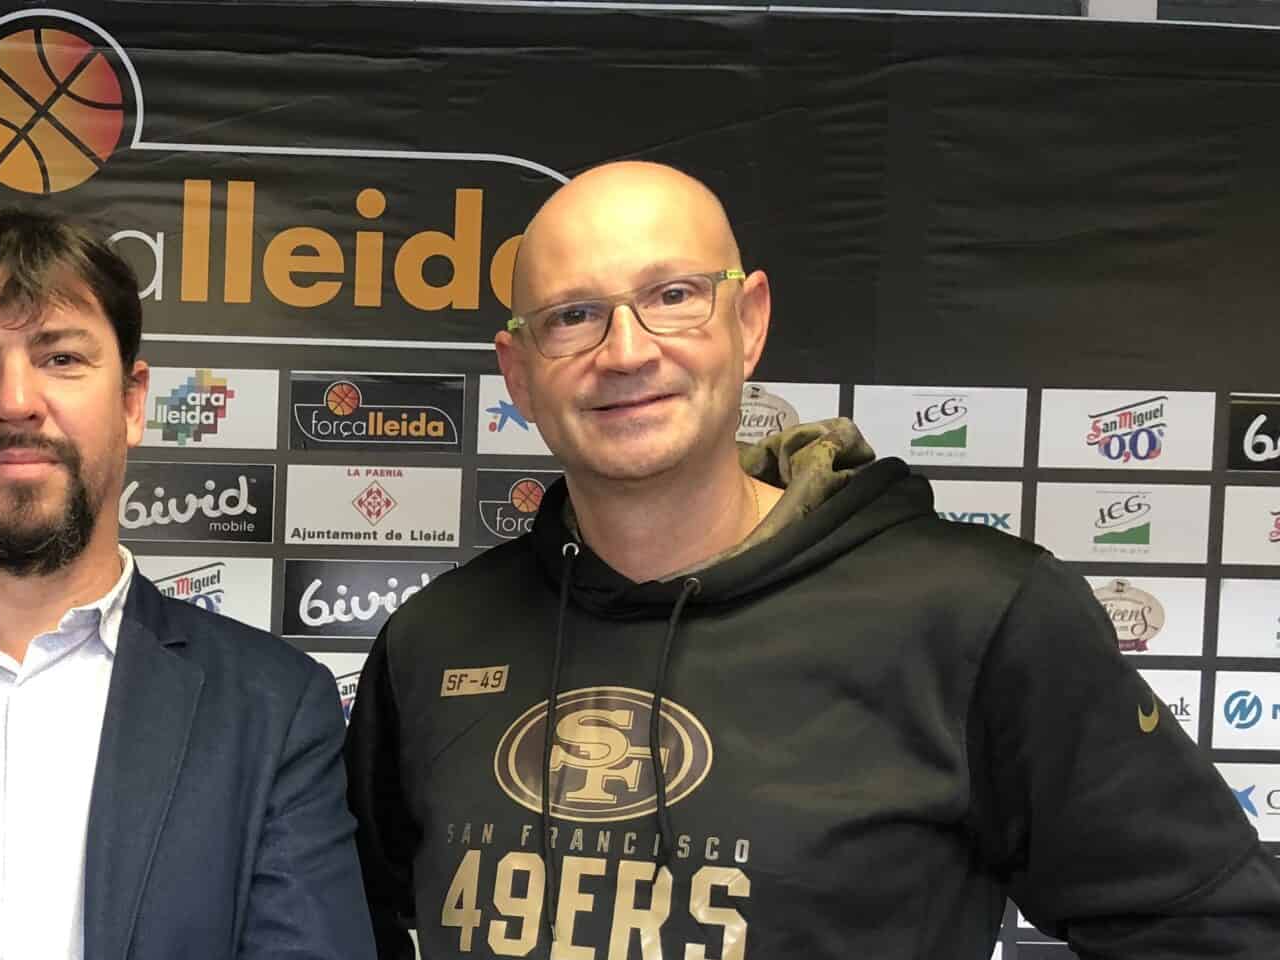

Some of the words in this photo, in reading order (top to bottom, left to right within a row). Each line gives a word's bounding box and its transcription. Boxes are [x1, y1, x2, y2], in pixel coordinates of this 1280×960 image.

[186, 392, 225, 406] ara
[156, 405, 215, 424] lleida
[915, 398, 959, 428] ICG
[347, 468, 360, 477] LA
[365, 468, 403, 478] PAERIA
[1098, 494, 1143, 525] ICG
[209, 520, 255, 533] mobile
[290, 527, 377, 541] Ajuntament
[385, 530, 402, 541] de
[410, 531, 455, 542] Lleida
[446, 670, 504, 692] SF-49
[446, 822, 494, 844] SAN
